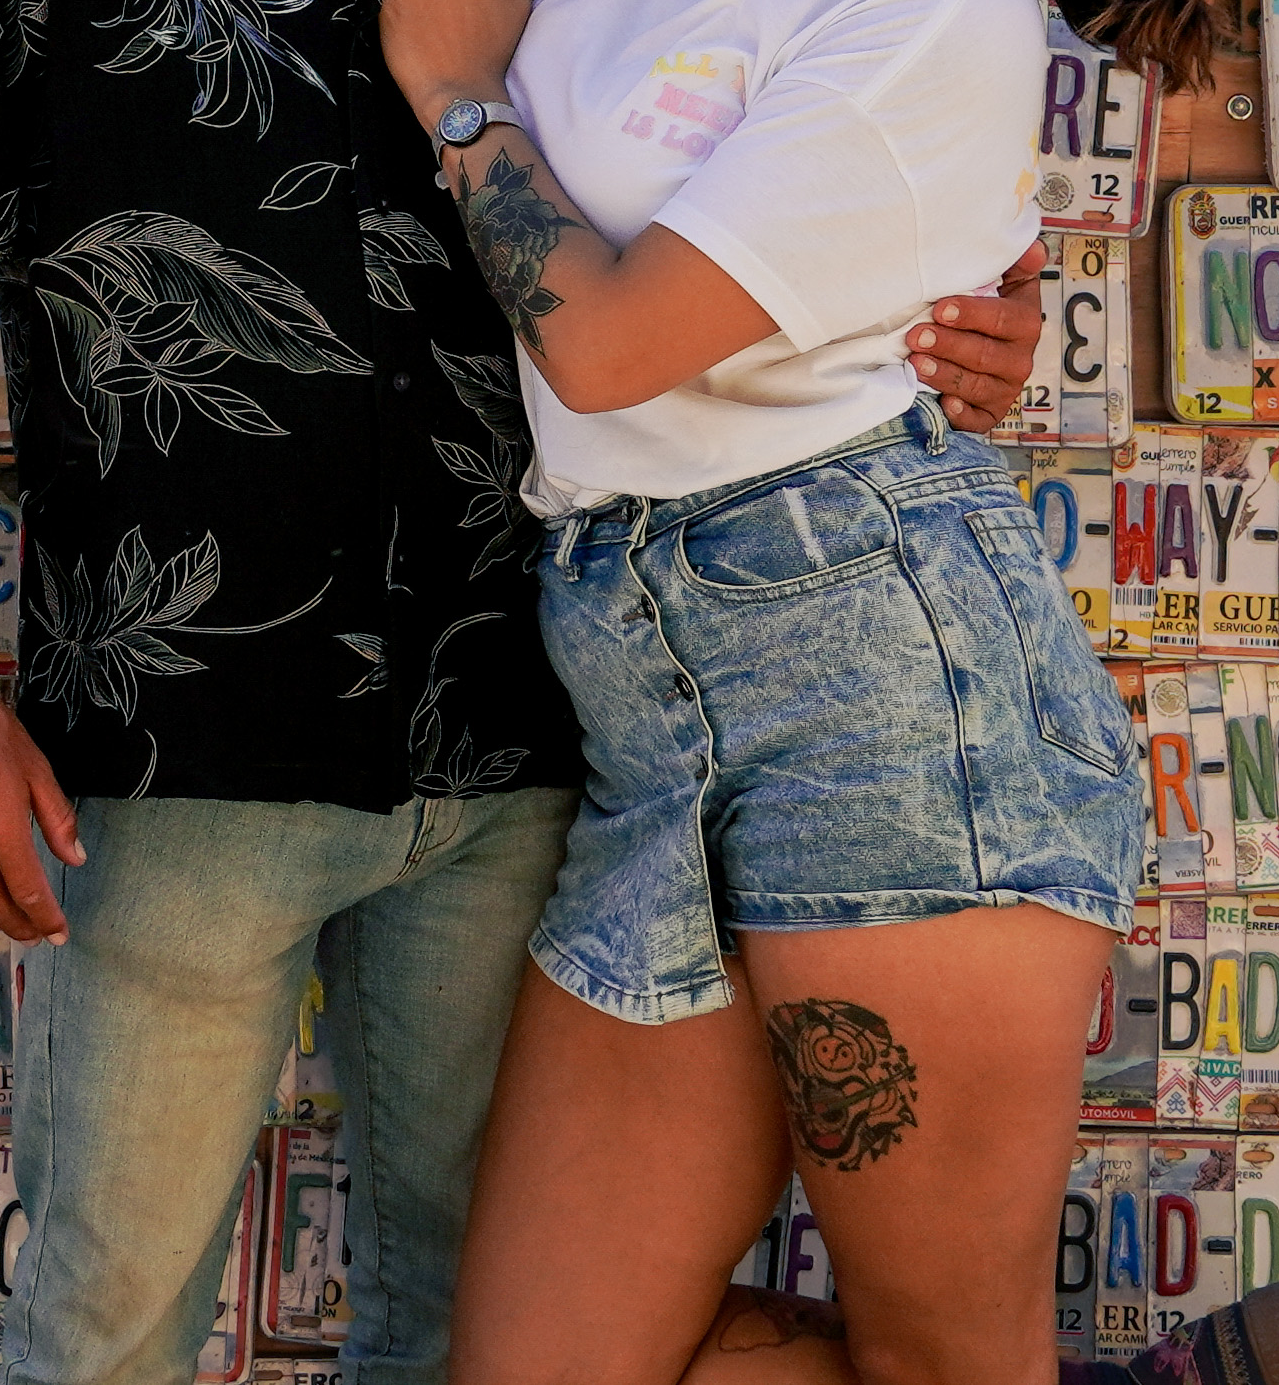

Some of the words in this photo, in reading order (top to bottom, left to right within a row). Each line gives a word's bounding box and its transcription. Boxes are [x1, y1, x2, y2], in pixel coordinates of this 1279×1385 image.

[1091, 173, 1120, 197] 12
[1024, 385, 1051, 408] 12
[1195, 392, 1222, 415] 12
